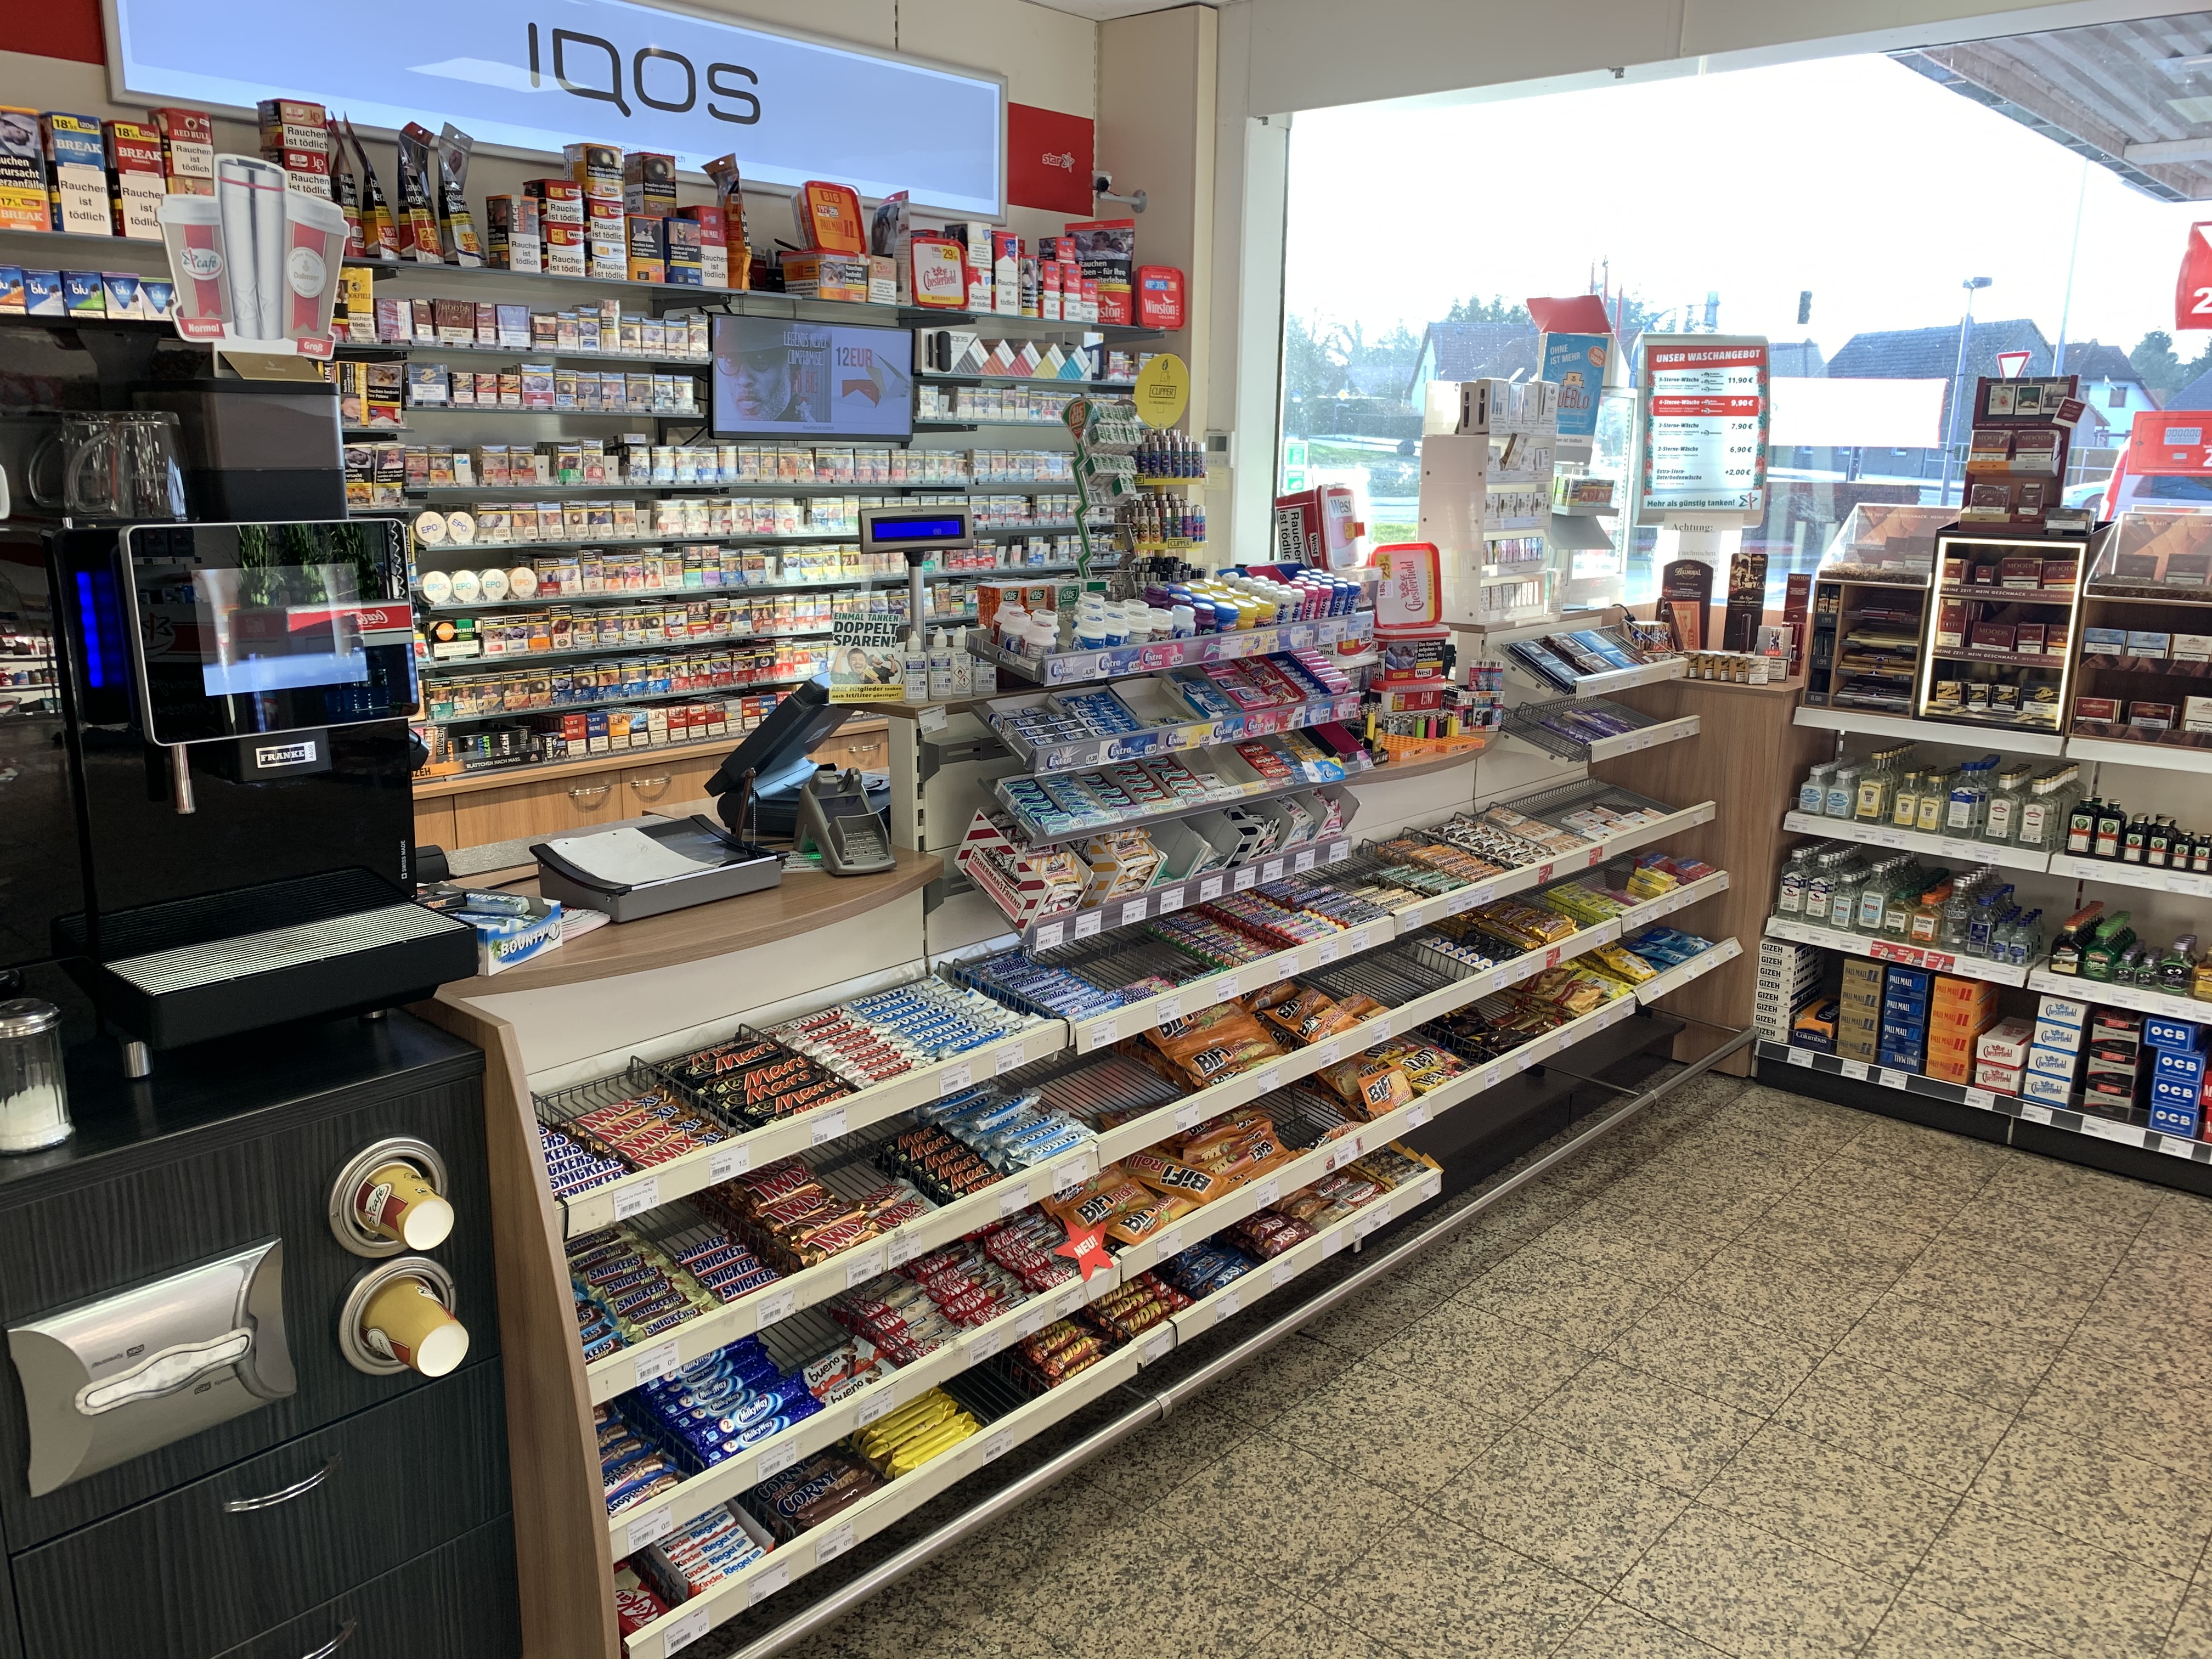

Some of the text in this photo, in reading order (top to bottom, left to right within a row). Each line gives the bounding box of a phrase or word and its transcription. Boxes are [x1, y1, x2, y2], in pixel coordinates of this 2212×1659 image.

[528, 22, 760, 125] IQOS
[174, 128, 208, 140] RED BULL
[287, 127, 326, 139] Rauchen
[56, 139, 102, 154] BREAK
[286, 137, 329, 149] ist tödlich
[117, 146, 162, 161] BREAK
[176, 145, 211, 156] Rauchen
[1042, 153, 1062, 166] star
[182, 163, 210, 173] tödlich
[0, 179, 44, 190] erzanfälle
[291, 173, 329, 185] Rauchen
[61, 180, 106, 193] Rauchen
[566, 188, 581, 196] West
[79, 197, 93, 206] ist
[823, 191, 839, 202] BIG
[140, 204, 153, 213] ist
[1, 210, 43, 222] BREAK
[69, 212, 105, 222] tödlich
[512, 241, 539, 250] Rauchen
[196, 257, 217, 273] café
[516, 257, 538, 266] tödlich
[294, 272, 319, 281] Dallmayr
[704, 270, 726, 279] tödlich
[923, 270, 957, 291] Chesterfield
[442, 304, 470, 312] MOODS
[1144, 298, 1175, 315] Winston
[188, 323, 219, 332] Normal
[784, 331, 809, 347] LEGENDS
[304, 341, 323, 352] Groß
[1550, 345, 1568, 355] OHNE
[788, 349, 823, 366] COMPROMISE
[1550, 352, 1581, 365] IST MEHR
[1656, 349, 1761, 363] UNSER WASCHANGEBOT
[1152, 387, 1174, 396] CLIPPER
[1558, 387, 1589, 409] UEBLO
[1330, 499, 1352, 514] West
[1679, 499, 1706, 509] günstig
[1671, 523, 1713, 532] Achtung:
[1282, 528, 1291, 560] tödlic
[833, 622, 899, 635] DOPPELT
[1979, 628, 2008, 636] MOODS
[833, 635, 897, 648] SPAREN!
[1145, 652, 1163, 661] Extra
[1053, 665, 1073, 676] Extra
[261, 749, 304, 761] FRANKE
[971, 853, 1022, 910] FISHERMAN'S FRIEND
[501, 927, 549, 957] BOUNTY
[1762, 943, 1783, 953] GIZEH
[1761, 956, 1782, 966] GIZEH
[1889, 975, 1912, 988] PALL MALL
[1758, 991, 1779, 1001] GIZEH
[1936, 985, 1960, 996] PALL MALL
[1887, 1000, 1910, 1012] PALL MALL
[2045, 1003, 2076, 1017] Chesterfield
[788, 1005, 842, 1030] BOUNTY
[890, 1004, 944, 1028] BOUNTY
[1756, 1014, 1776, 1025] GIZEH
[1796, 1031, 1827, 1044] Columbus
[2041, 1030, 2072, 1043] Chesterfield
[2151, 1026, 2186, 1041] OCB
[716, 1042, 777, 1075] Mars
[1983, 1045, 2012, 1059] Chesterfield
[1192, 1046, 1233, 1077] BiFi
[2162, 1056, 2197, 1072] OCB
[744, 1056, 809, 1090] Mars
[747, 1070, 810, 1105] Mars
[2158, 1084, 2193, 1098] OCB
[910, 1133, 952, 1162] Mars
[1130, 1155, 1165, 1172] Roll
[550, 1157, 622, 1189] SNICKERS
[1161, 1166, 1212, 1194] BiFi
[744, 1164, 814, 1204] TWIX
[1075, 1194, 1115, 1225] BiFi
[802, 1218, 866, 1254] TWIX
[1271, 1226, 1299, 1245] YES!
[1073, 1235, 1098, 1259] NEU!
[589, 1255, 641, 1282] SNICKERS
[622, 1265, 638, 1275] WHITE
[957, 1256, 978, 1272] CHUNKY
[606, 1266, 658, 1294] SNICKERS
[1215, 1266, 1243, 1285] YES!
[1128, 1301, 1161, 1333] LION
[1060, 1336, 1093, 1363] LION
[808, 1356, 840, 1384] bueno
[738, 1397, 768, 1422] MilkyWay
[724, 1420, 729, 1429] 2
[743, 1420, 773, 1442] MilkyWay
[776, 1472, 838, 1517] CORNY
[690, 1521, 719, 1539] Riegel
[702, 1535, 730, 1554] Riegel
